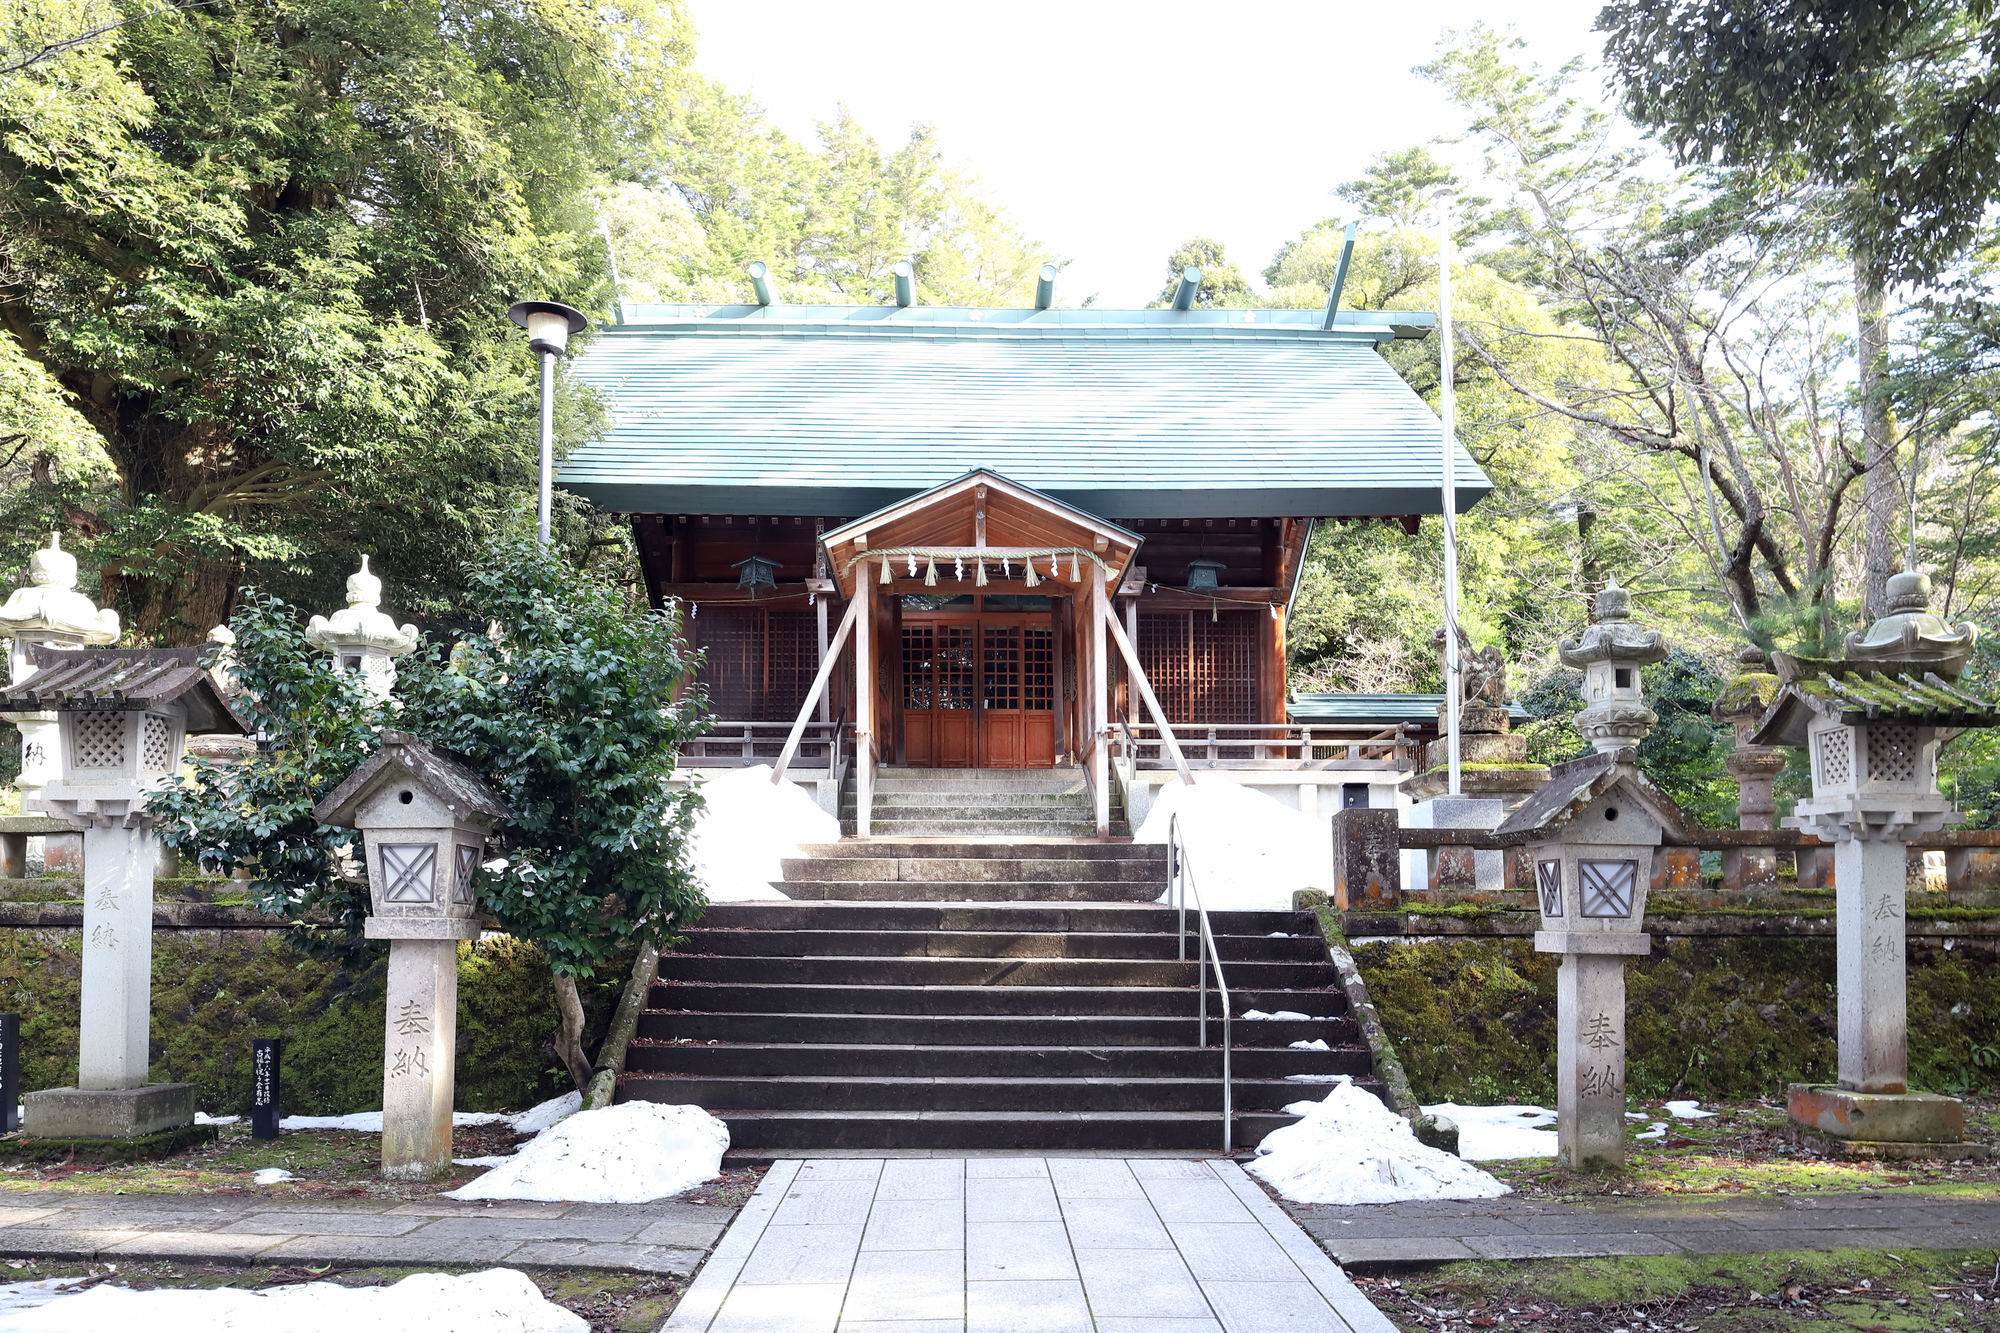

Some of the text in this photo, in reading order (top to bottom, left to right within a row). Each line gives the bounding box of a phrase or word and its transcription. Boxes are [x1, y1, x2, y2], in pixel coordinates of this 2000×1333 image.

[91, 886, 121, 949] 奉納
[1872, 893, 1901, 962] 奉納
[390, 999, 430, 1079] 奉納
[1581, 1012, 1622, 1099] 奉納
